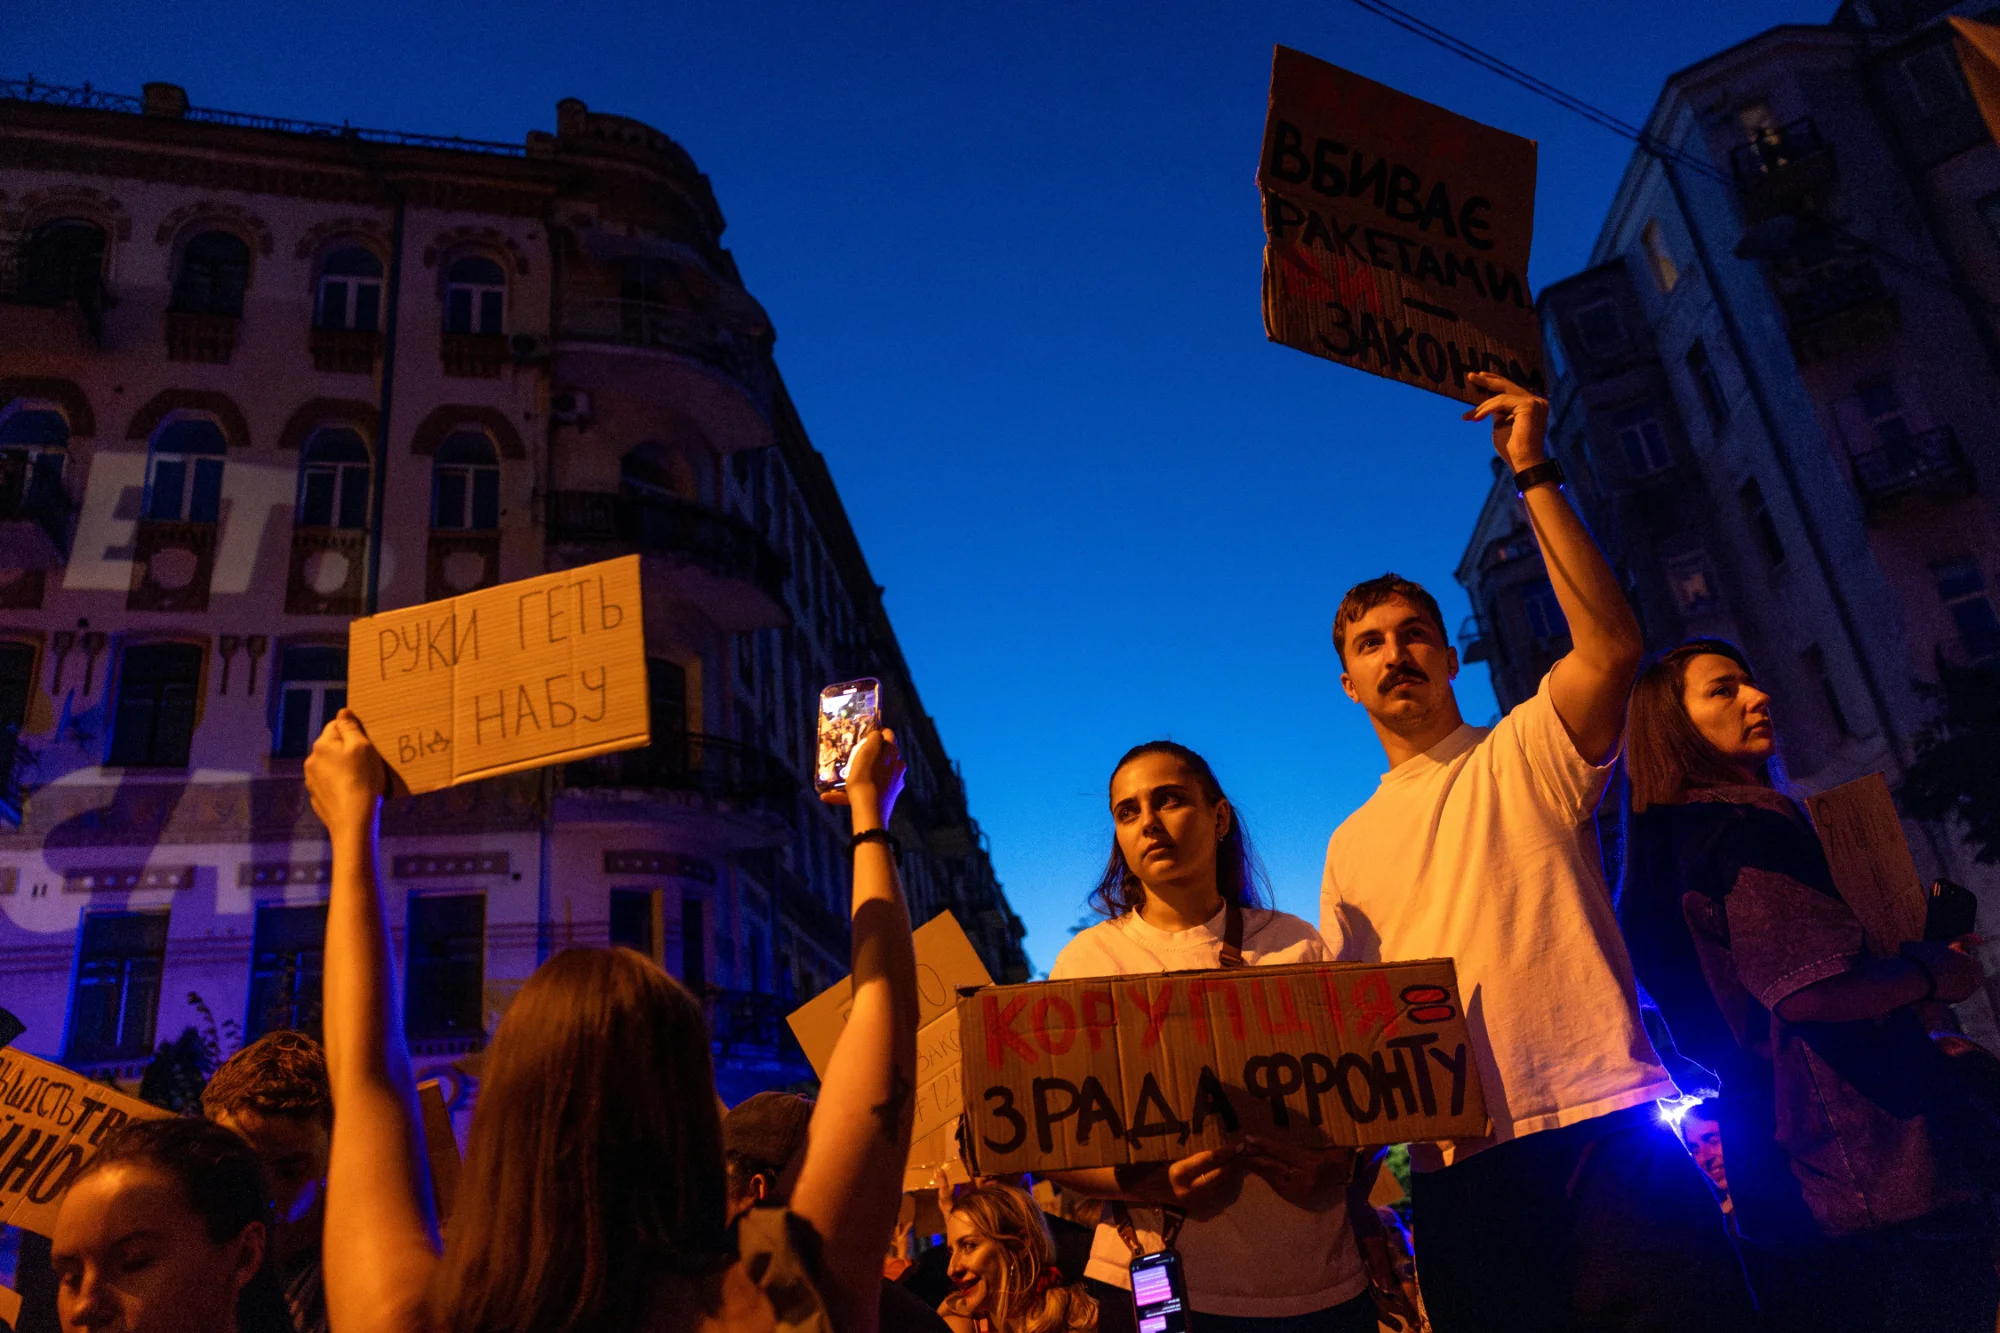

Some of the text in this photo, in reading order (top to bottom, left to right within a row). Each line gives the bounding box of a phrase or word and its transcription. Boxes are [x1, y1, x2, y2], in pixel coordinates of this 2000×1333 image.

[1270, 119, 1493, 250] ВБИВАЄ
[378, 575, 624, 681] РУКИ ГЕТЬ
[474, 666, 606, 745] НАБУ
[981, 968, 1399, 1070] КОРУПЦІЯ
[1244, 1032, 1467, 1127] ФРОНТУ
